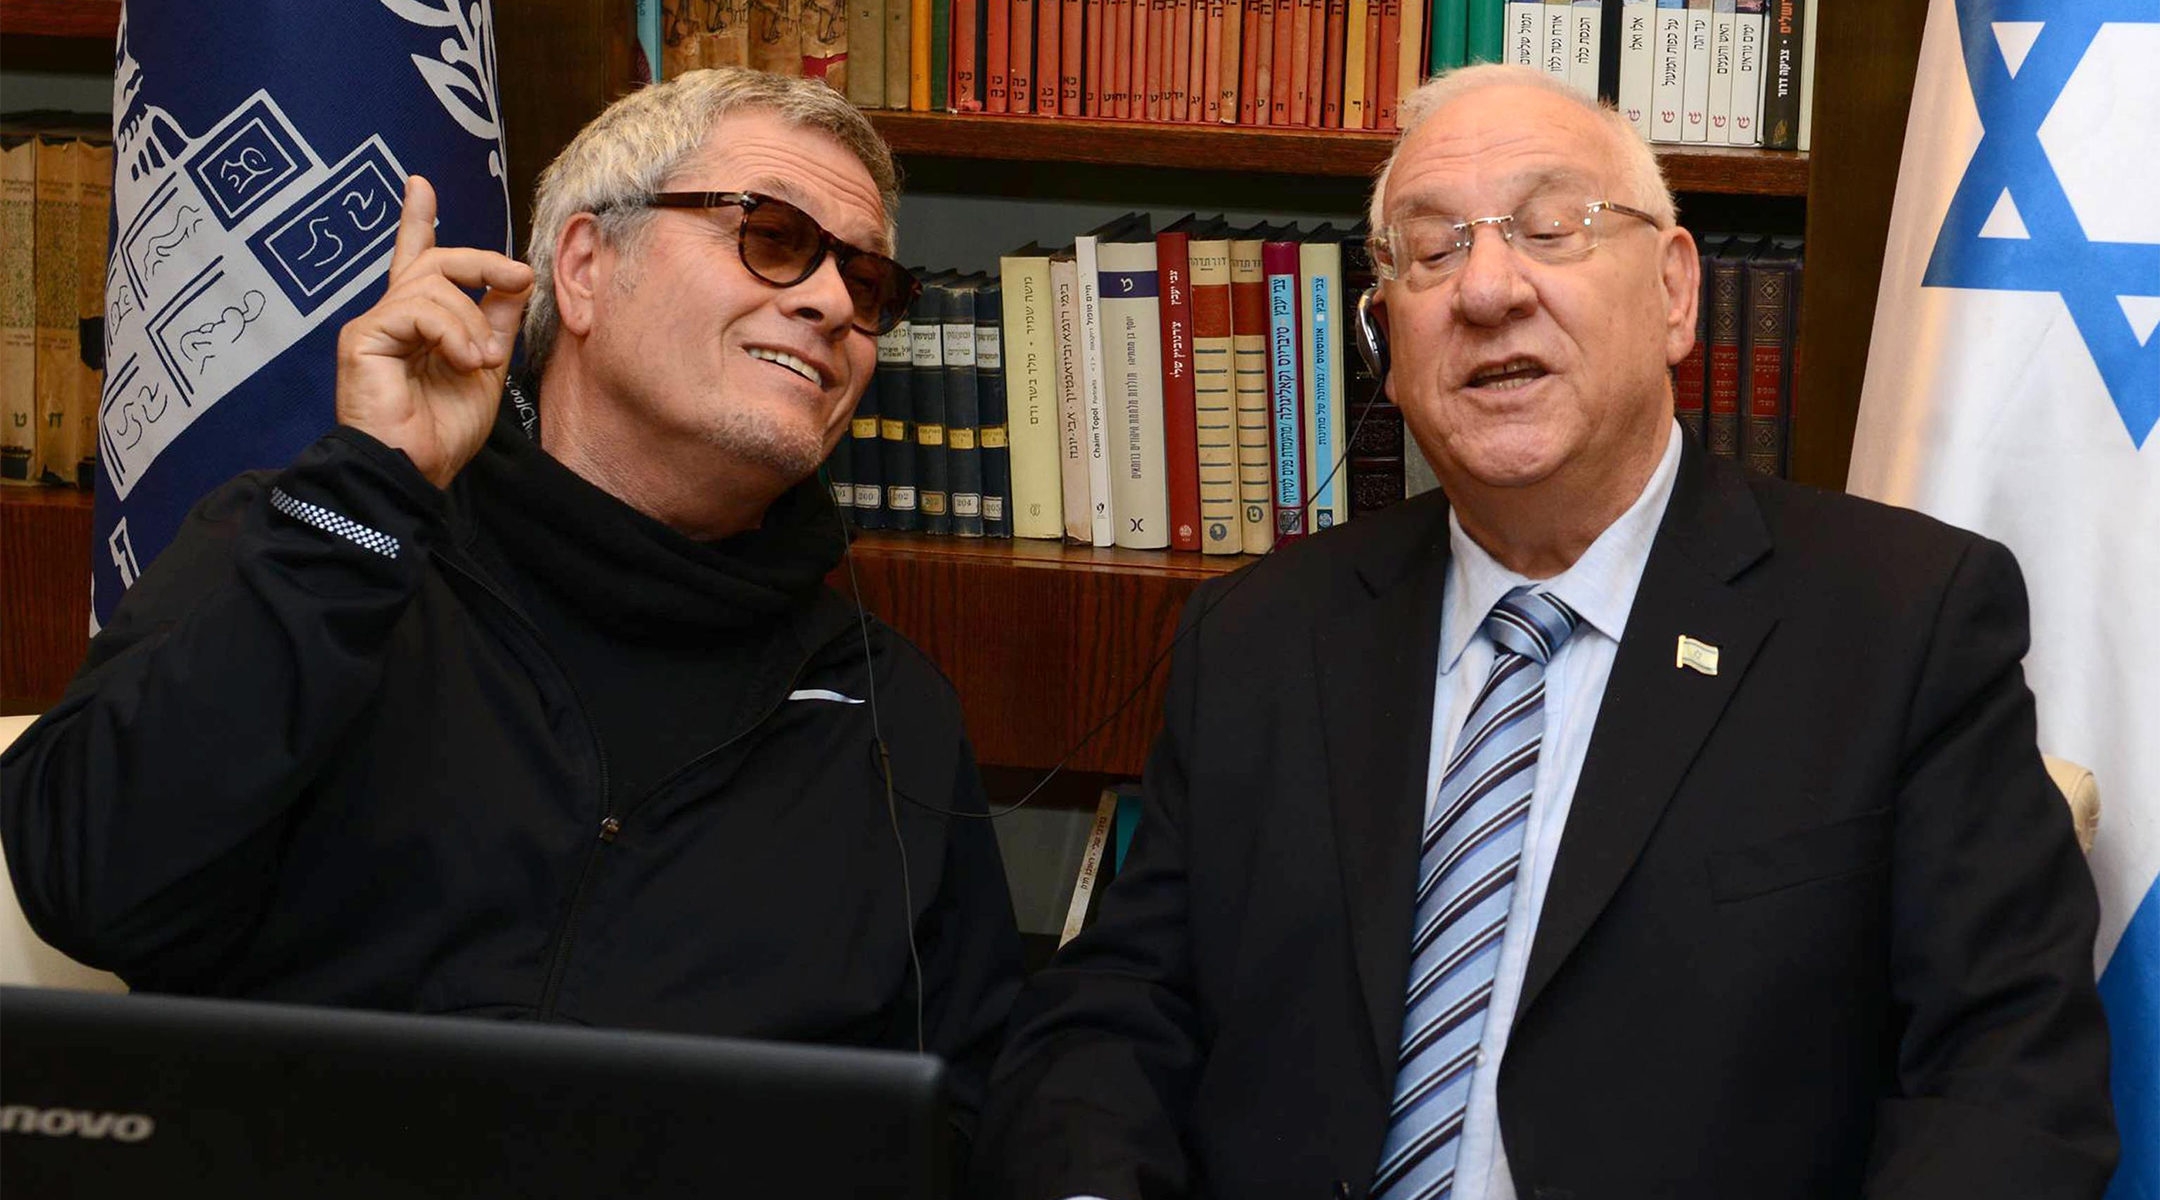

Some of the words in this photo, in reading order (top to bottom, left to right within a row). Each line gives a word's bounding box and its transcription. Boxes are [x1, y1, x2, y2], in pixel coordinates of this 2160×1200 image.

[1518, 13, 1532, 34] תמול
[1552, 14, 1563, 36] אורח
[1579, 17, 1591, 45] הכנסת
[1629, 17, 1644, 31] אלו
[1664, 18, 1679, 31] על
[1694, 19, 1706, 32] עד
[1719, 23, 1730, 43] האש
[1743, 23, 1754, 43] ימים
[1517, 36, 1531, 66] שלשום
[1551, 38, 1563, 54] נטה
[1628, 34, 1643, 51] ואלו
[1667, 32, 1678, 54] כפות
[1693, 34, 1705, 50] הנה
[1575, 47, 1590, 64] כלה
[1717, 45, 1729, 75] והעצים
[1741, 45, 1753, 72] נוראים
[1779, 49, 1792, 77] צביקה
[1063, 76, 1077, 86] כא
[1661, 57, 1677, 87] המנעול
[990, 88, 1005, 98] כח
[1778, 77, 1789, 98] דרור
[1169, 270, 1179, 284] צבי
[1272, 278, 1286, 294] צבי
[1315, 277, 1324, 292] צבי
[1024, 276, 1034, 303] משה
[1060, 283, 1070, 307] בימי
[1085, 284, 1093, 302] חיים
[1170, 286, 1182, 306] יעבץ
[1273, 295, 1291, 316] יעבץ
[1315, 294, 1326, 313] יעבץ
[1025, 305, 1035, 335] שמיר
[1085, 303, 1094, 326] טופול
[1126, 316, 1136, 331] יוסף
[1061, 310, 1072, 342] רומא
[1126, 332, 1136, 340] בן
[1126, 341, 1136, 366] מתתיהו
[1276, 326, 1291, 367] טיבריוס
[1027, 353, 1038, 375] מלך
[1062, 344, 1077, 403] וביזאנטיון
[1169, 360, 1183, 378] שלי
[1028, 378, 1038, 402] בשר
[1126, 372, 1138, 397] תולדות
[1276, 370, 1295, 420] וקאליגולה
[1316, 373, 1326, 401] נצחונה
[1029, 404, 1039, 425] ודם
[1091, 407, 1100, 431] Topol
[1126, 399, 1139, 424] מלחמת
[1316, 402, 1325, 415] של
[1128, 425, 1140, 451] היהודים
[1317, 417, 1327, 446] מתינות
[1091, 432, 1101, 459] Chaim
[1130, 453, 1142, 480] ברומאים
[1281, 459, 1294, 476] פנים
[857, 492, 874, 501] 200
[1280, 478, 1298, 504] לטירוף
[956, 497, 972, 508] 204
